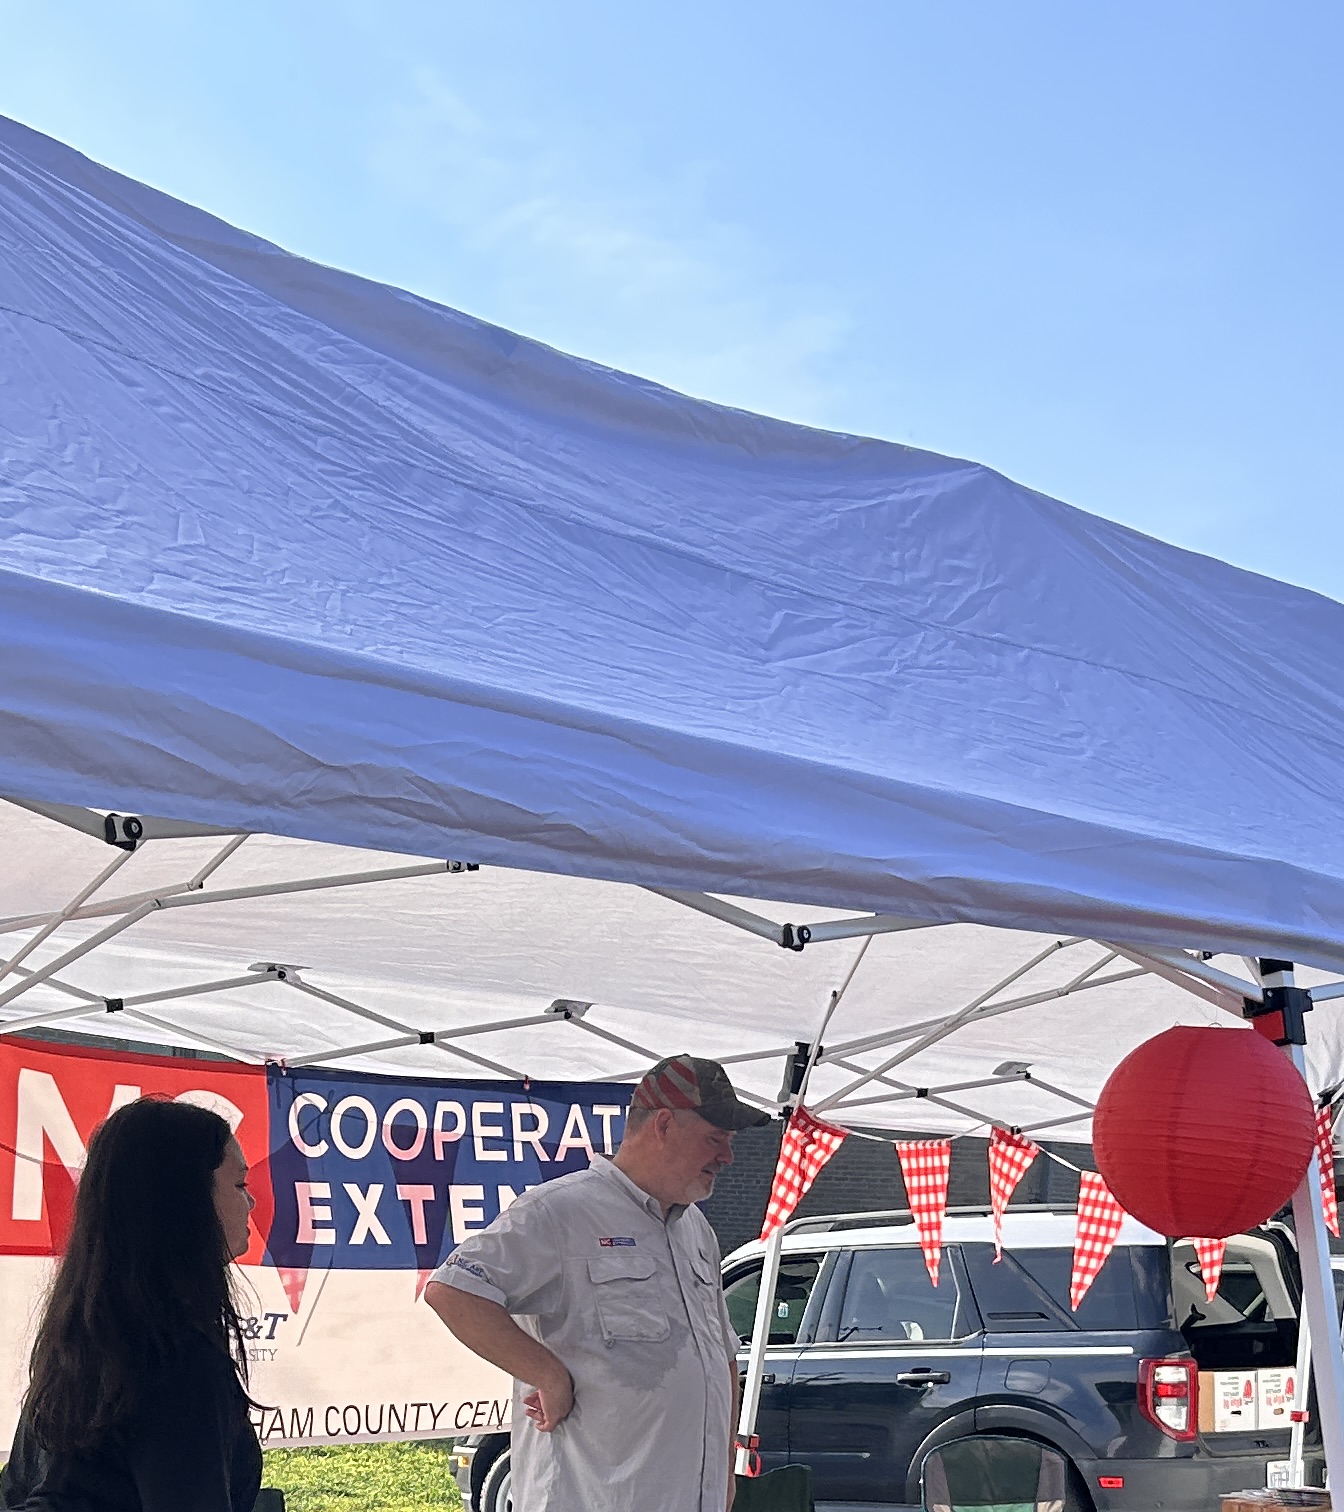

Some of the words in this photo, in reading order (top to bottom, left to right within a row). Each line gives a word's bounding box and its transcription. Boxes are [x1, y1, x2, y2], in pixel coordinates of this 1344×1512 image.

[12, 1067, 245, 1221] N
[288, 1092, 630, 1162] COOPERAT
[228, 1312, 289, 1340] &T
[247, 1407, 314, 1440] HAM
[325, 1402, 449, 1434] COUNTY
[454, 1398, 513, 1430] CEN
